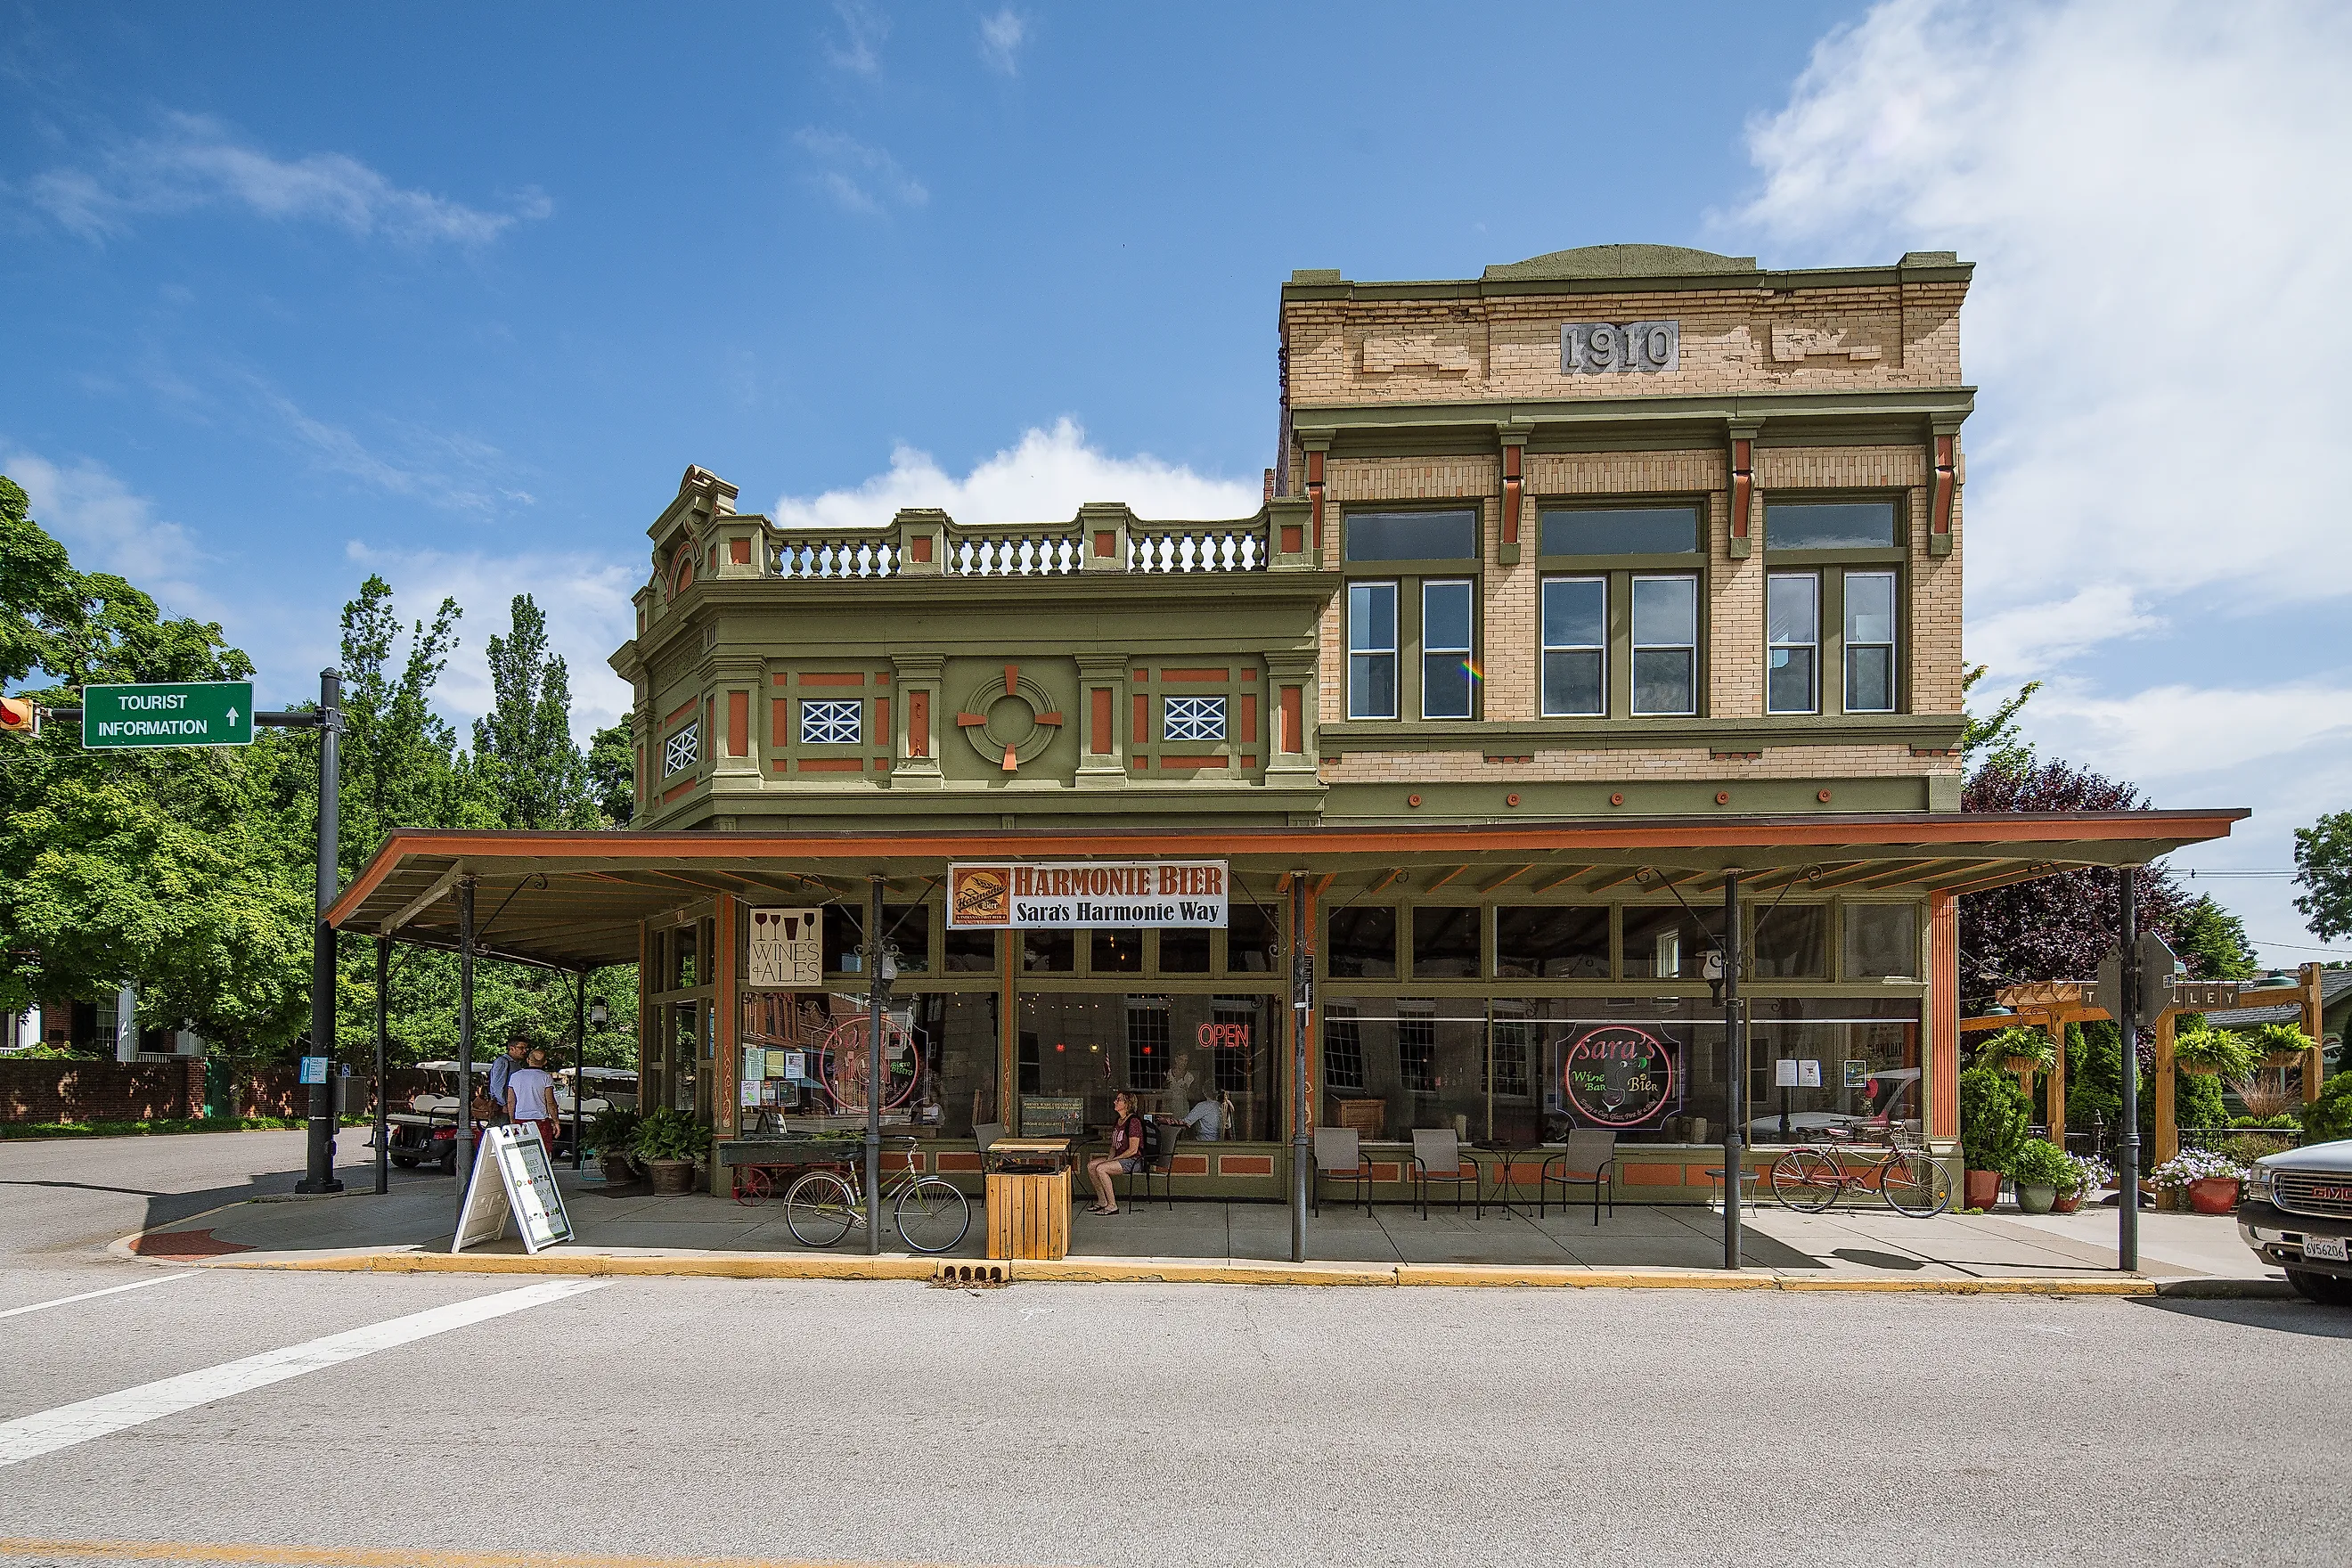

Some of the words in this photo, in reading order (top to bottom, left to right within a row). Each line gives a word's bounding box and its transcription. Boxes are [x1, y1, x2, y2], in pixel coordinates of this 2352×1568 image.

[1568, 326, 1674, 367] 1910
[118, 695, 188, 710] TOURIST
[98, 720, 208, 737] INFORMATION
[1013, 866, 1152, 896] HARMONIE
[1158, 865, 1223, 895] BIER
[1017, 902, 1070, 921] Sara's
[1076, 902, 1174, 921] Harmonie
[1179, 902, 1220, 922] Way
[752, 943, 820, 961] WINES
[1197, 1023, 1249, 1048] OPEN
[1578, 1034, 1656, 1059] Sara's
[1572, 1070, 1605, 1082] Wine
